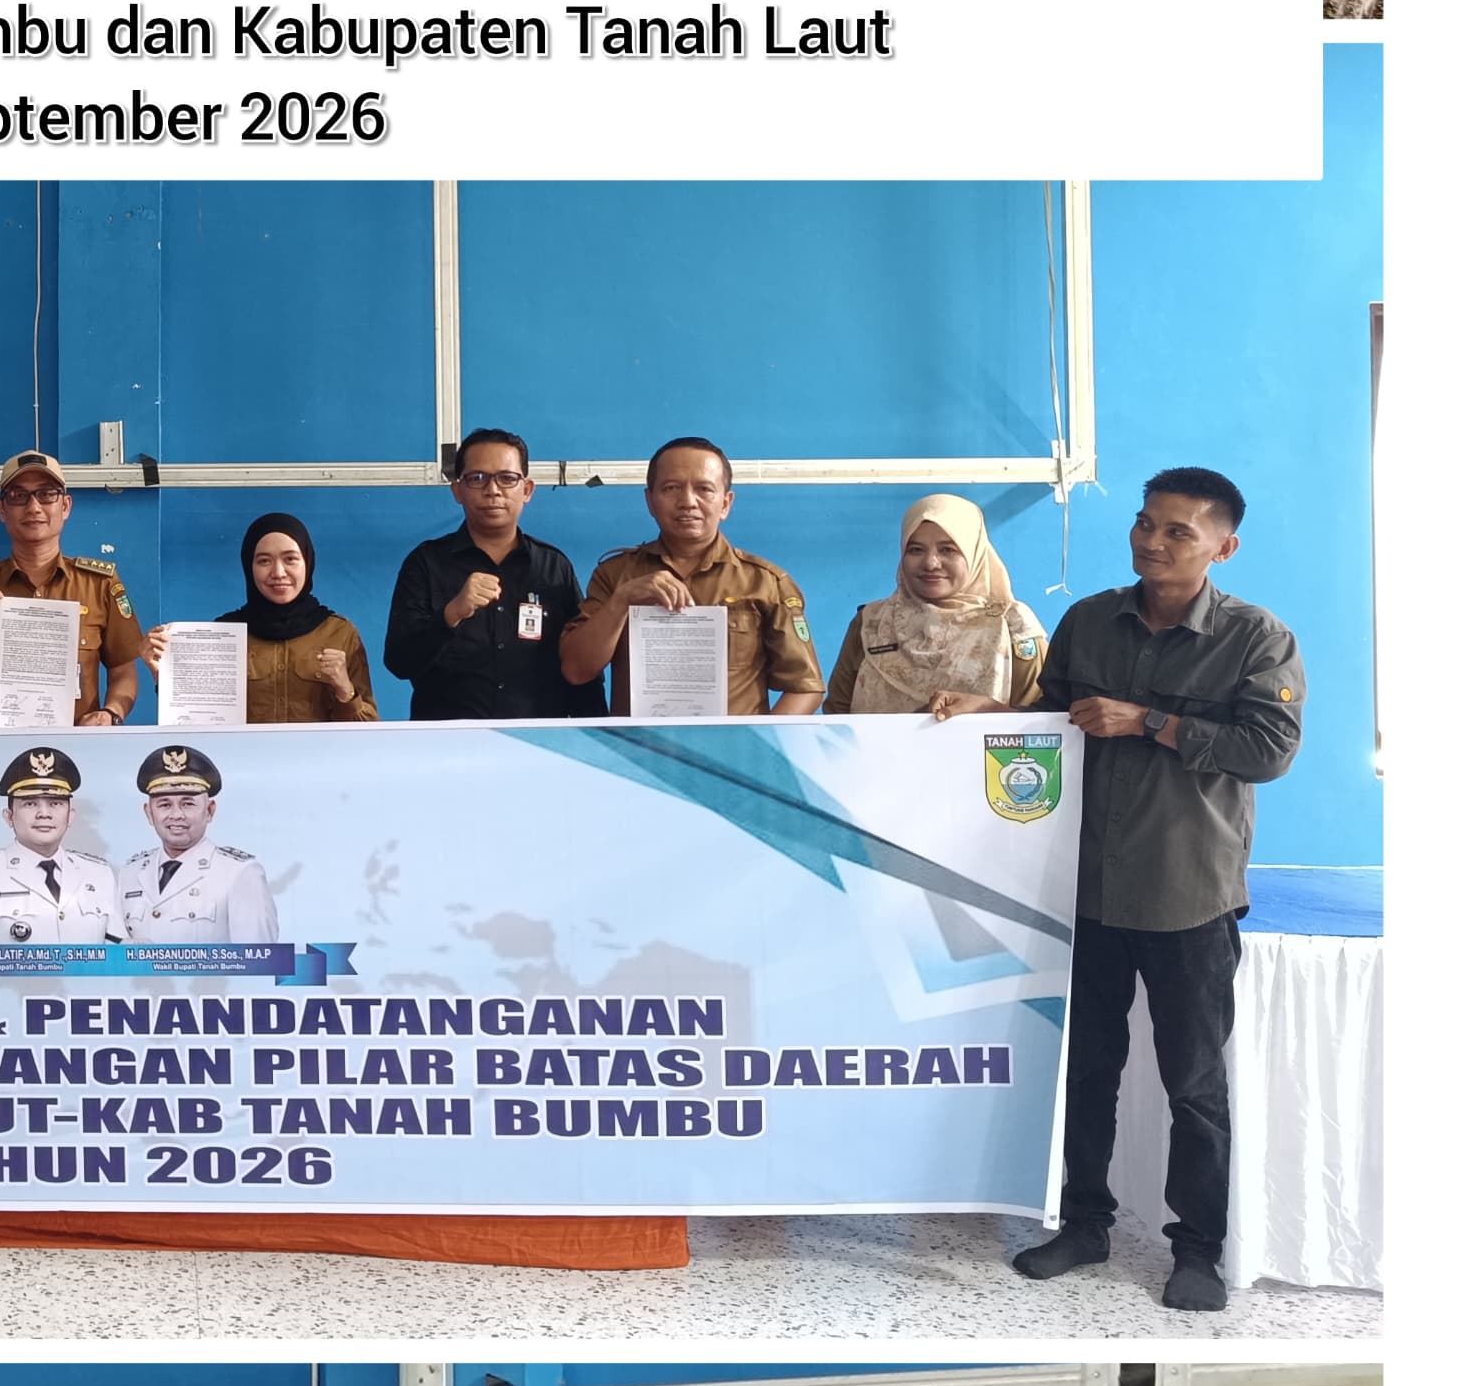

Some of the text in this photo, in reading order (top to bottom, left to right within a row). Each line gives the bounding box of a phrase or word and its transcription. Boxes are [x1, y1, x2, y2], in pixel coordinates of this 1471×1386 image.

[986, 736, 1058, 747] TANAH LAUT
[27, 949, 52, 961] A.Md.
[53, 949, 62, 961] T
[126, 948, 272, 961] H. BAHSANUDDIN, S.Sos., M.A.P
[15, 963, 37, 971] Tanah
[37, 963, 63, 971] Bumbu
[153, 963, 246, 972] Wakil Bupati Tanah Bumbu
[25, 998, 724, 1036] PENANDATANGANAN
[252, 1048, 454, 1086] PILAR
[476, 1049, 704, 1087] BATAS
[724, 1047, 1011, 1087] DAERAH
[241, 1098, 472, 1135] TANAH
[494, 1099, 764, 1137] BUMBU
[146, 1146, 332, 1185] 2026
